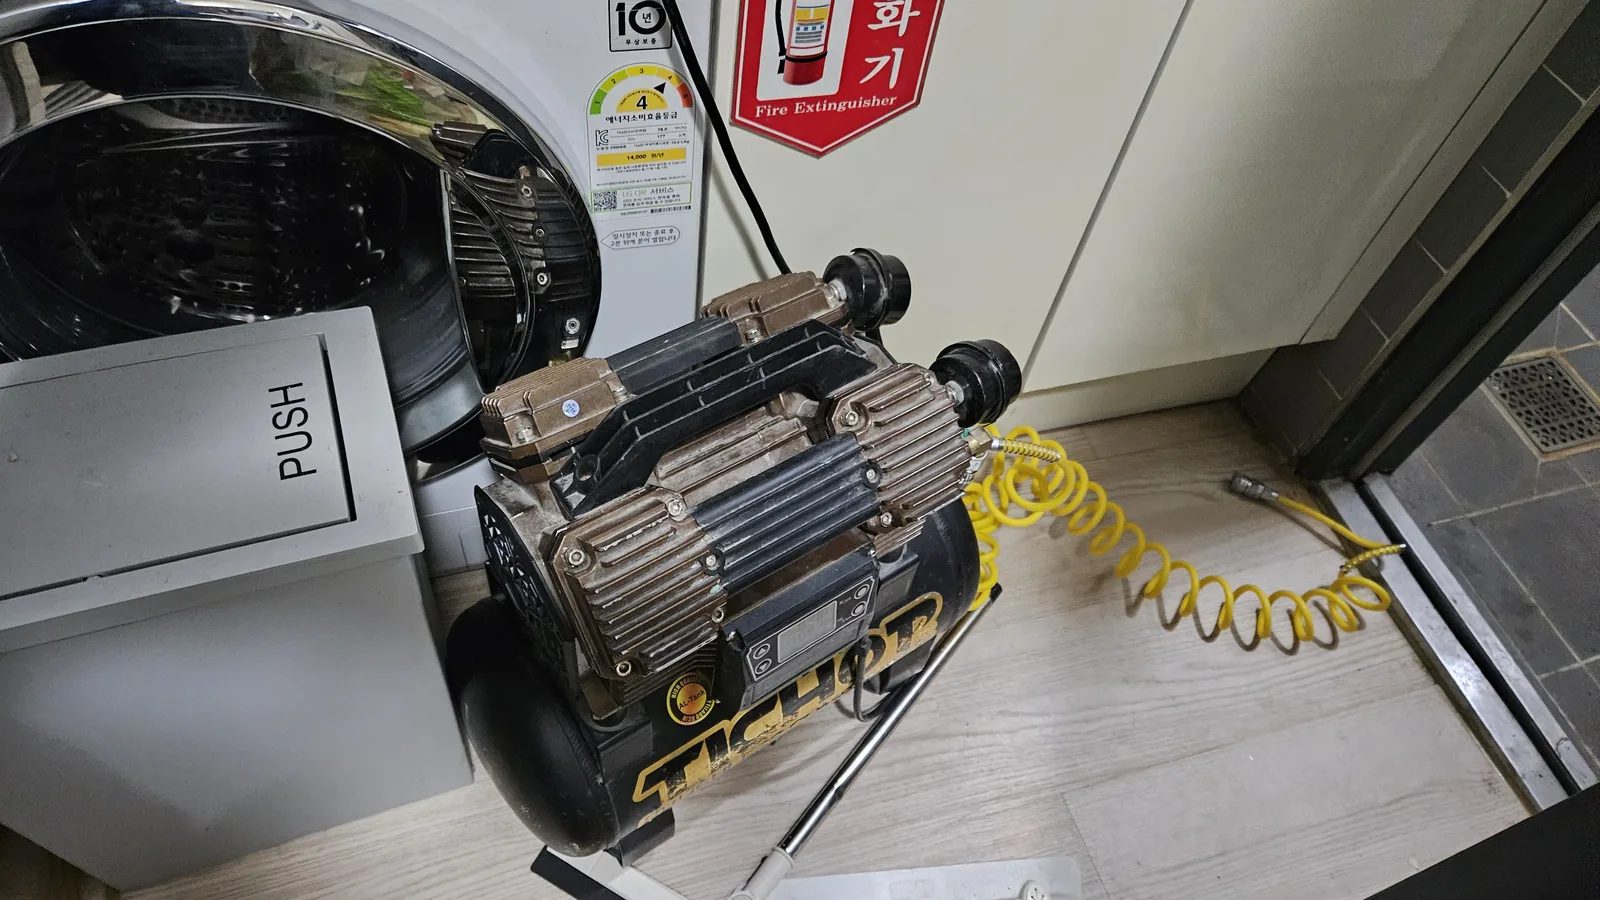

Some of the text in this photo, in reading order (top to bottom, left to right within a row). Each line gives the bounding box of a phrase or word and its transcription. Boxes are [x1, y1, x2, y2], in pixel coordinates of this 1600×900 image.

[636, 95, 648, 110] 4
[755, 95, 897, 118] Fire Extinguisher
[605, 111, 678, 124] 에너지소비효율등급
[650, 187, 674, 195] 서비스
[612, 231, 638, 241] 일시정지
[639, 230, 652, 238] 또는
[651, 235, 677, 244] 열립니다
[268, 382, 318, 481] PUSH
